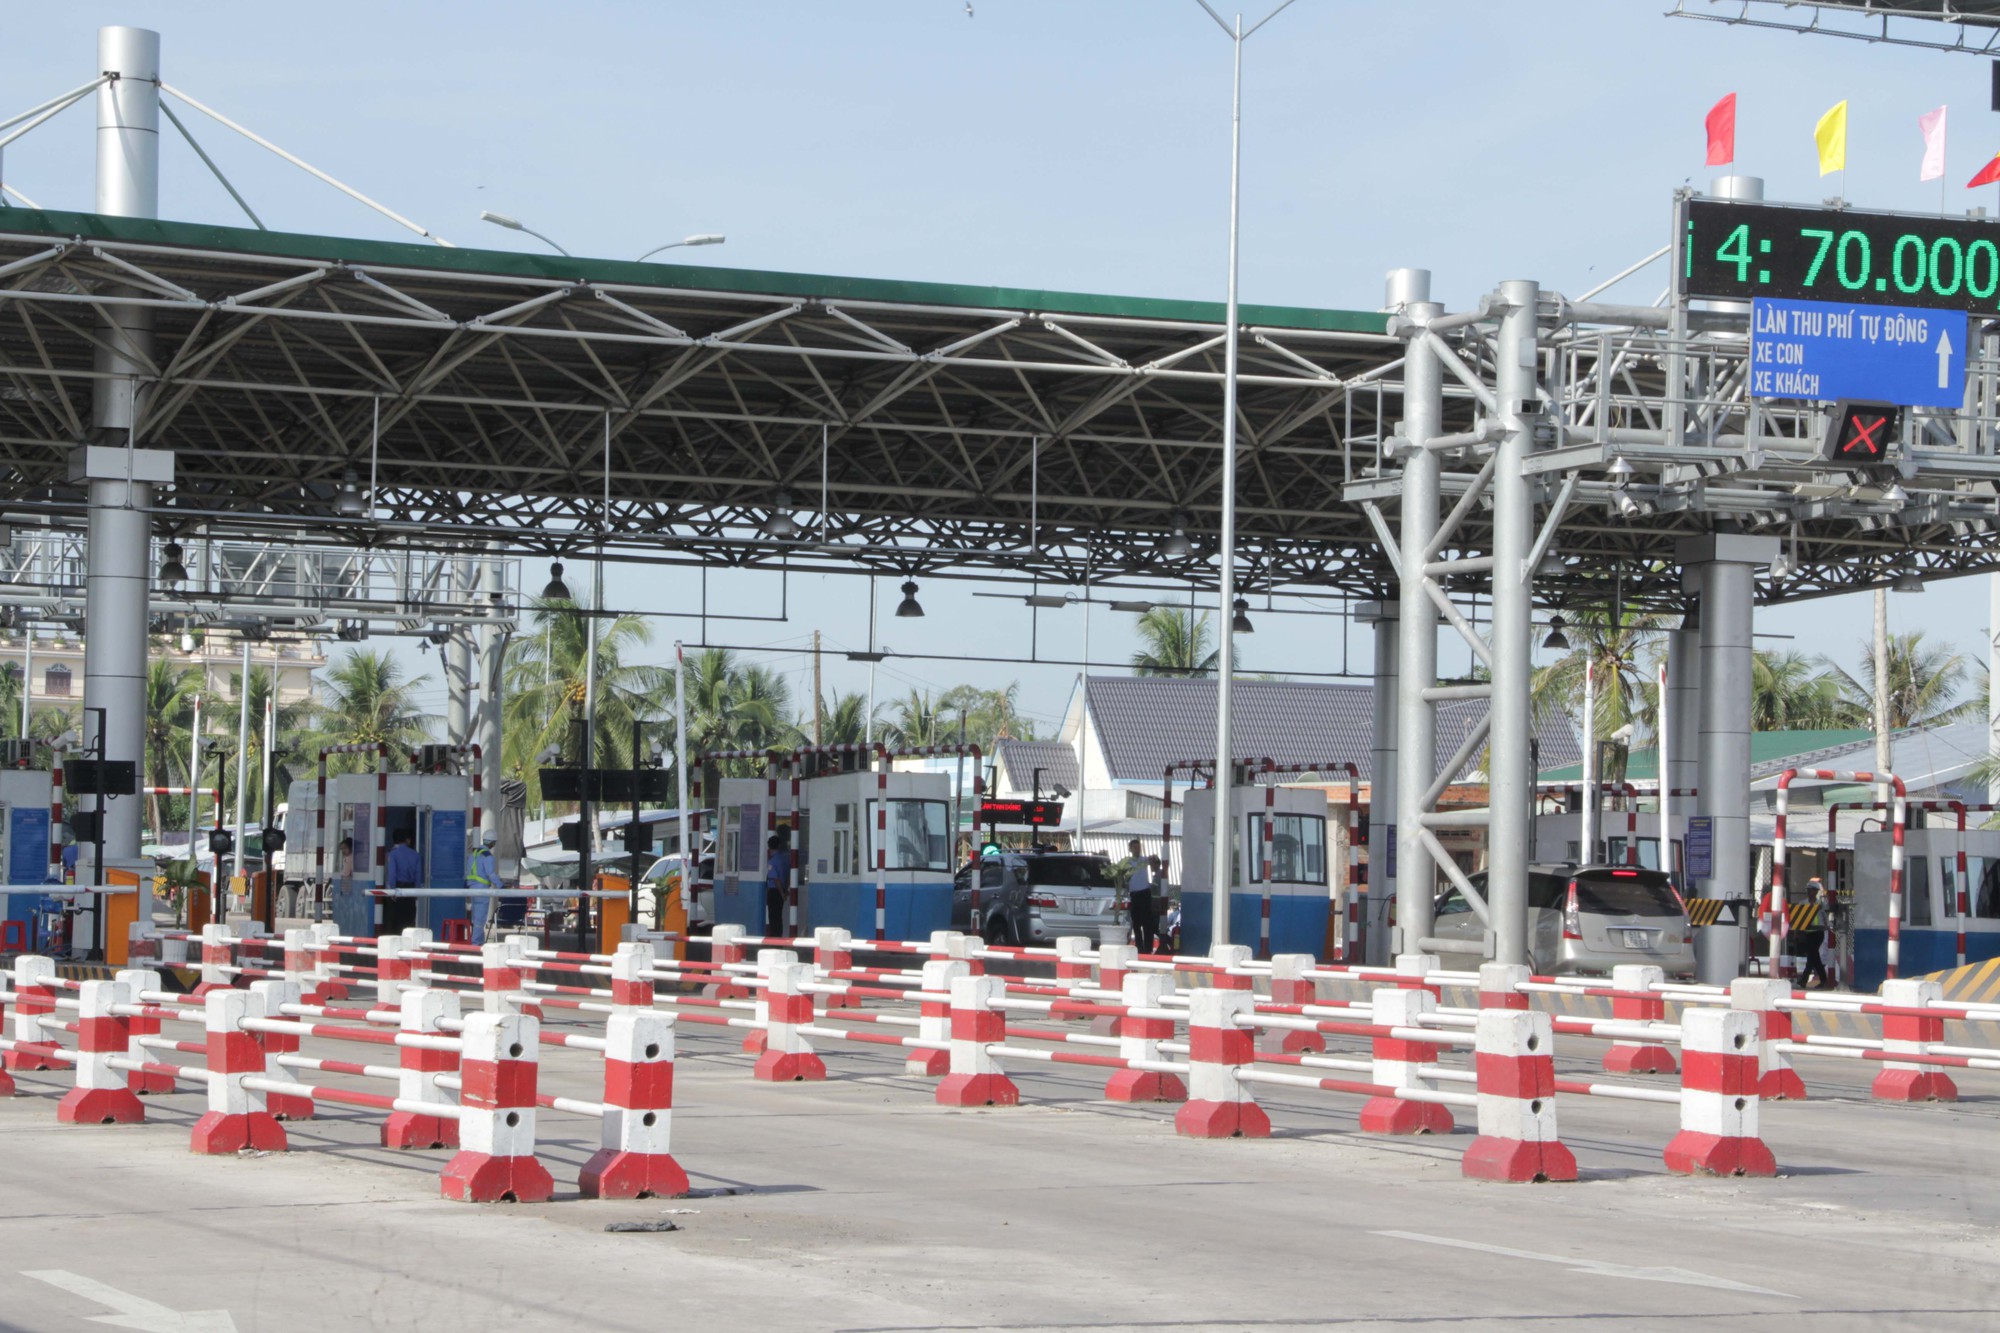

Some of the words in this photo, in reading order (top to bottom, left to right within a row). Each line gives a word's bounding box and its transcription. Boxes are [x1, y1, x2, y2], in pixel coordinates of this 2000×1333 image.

[1716, 224, 1772, 284] 4:
[1800, 229, 2000, 310] 70.000
[1756, 303, 1788, 335] LÀN
[1791, 310, 1823, 337] THU
[1827, 309, 1856, 339] PHÍ
[1859, 314, 1882, 345] TỰ
[1884, 312, 1928, 347] ĐỘNG
[1755, 341, 1773, 364] XE
[1776, 342, 1804, 365] CON
[1754, 370, 1773, 393] XE
[1775, 368, 1820, 396] KHÁCH
